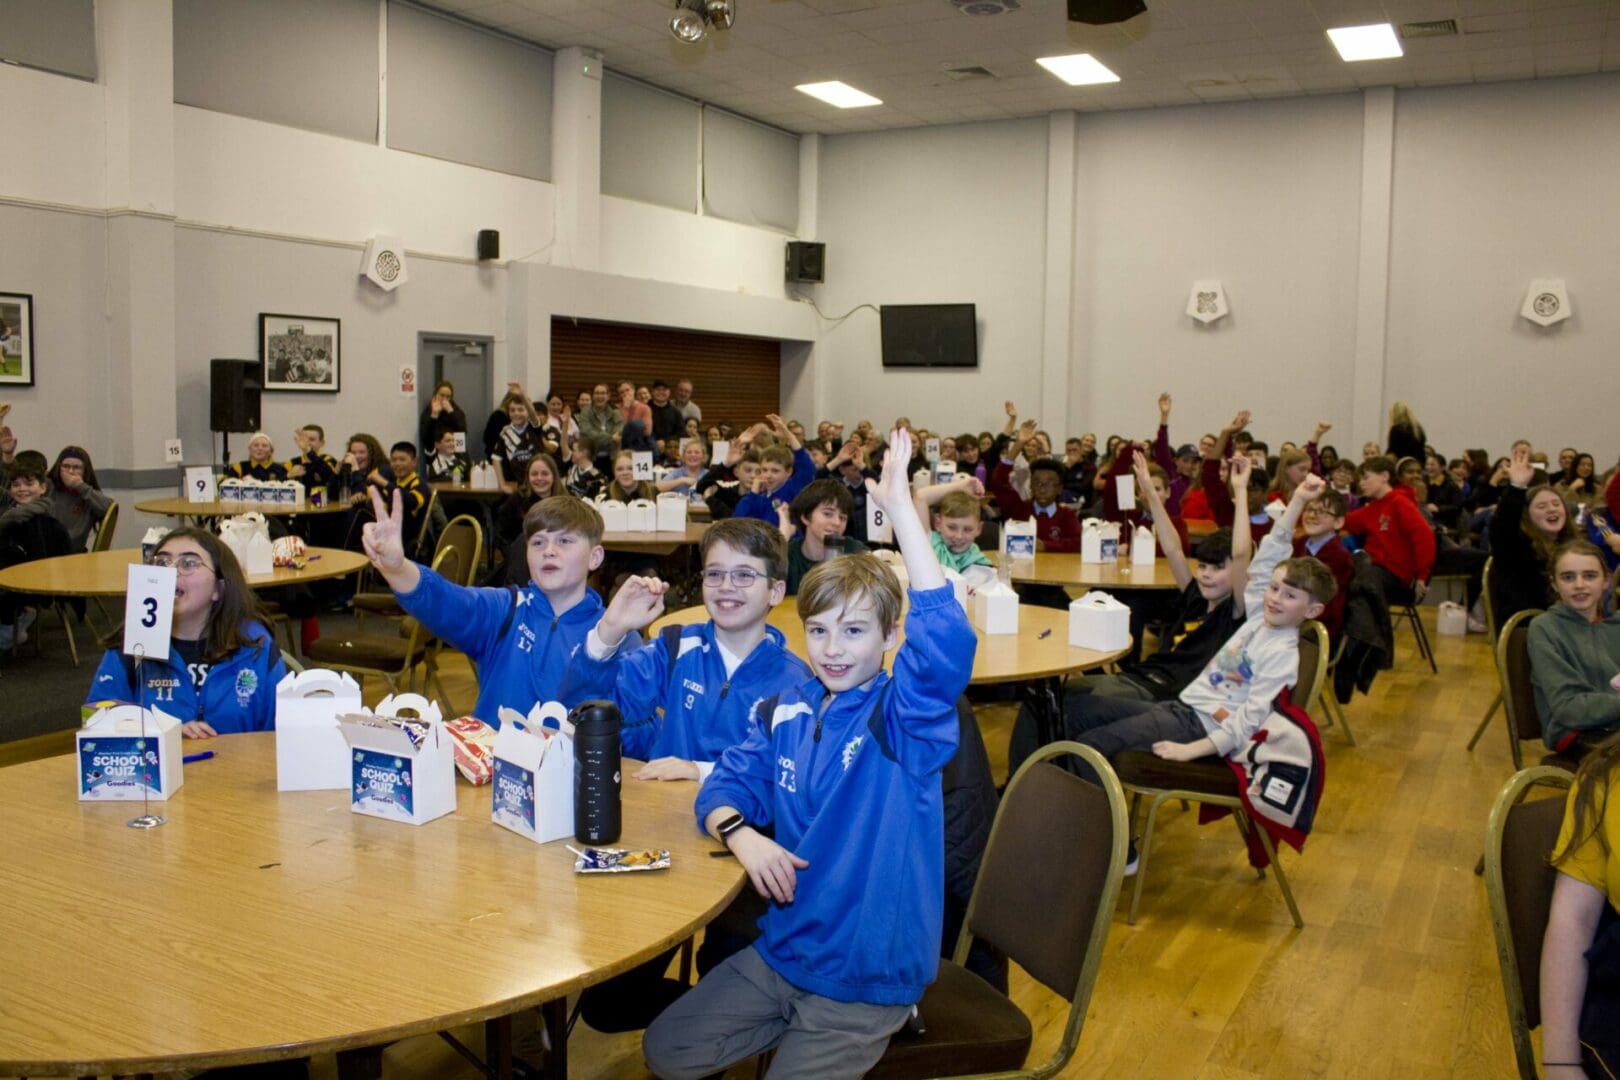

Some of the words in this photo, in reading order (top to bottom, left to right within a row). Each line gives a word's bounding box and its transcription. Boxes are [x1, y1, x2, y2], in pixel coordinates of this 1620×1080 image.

[169, 447, 180, 456] 15
[635, 462, 649, 473] 14
[196, 480, 206, 492] 9
[874, 510, 883, 526] 8
[141, 597, 158, 628] 3
[518, 636, 532, 653] 17
[155, 687, 174, 701] 11
[92, 755, 146, 767] SCHOOL
[104, 765, 137, 777] QUIZ
[361, 767, 403, 786] SCHOOL
[369, 779, 395, 794] QUIZ
[498, 777, 528, 800] SCHOOL
